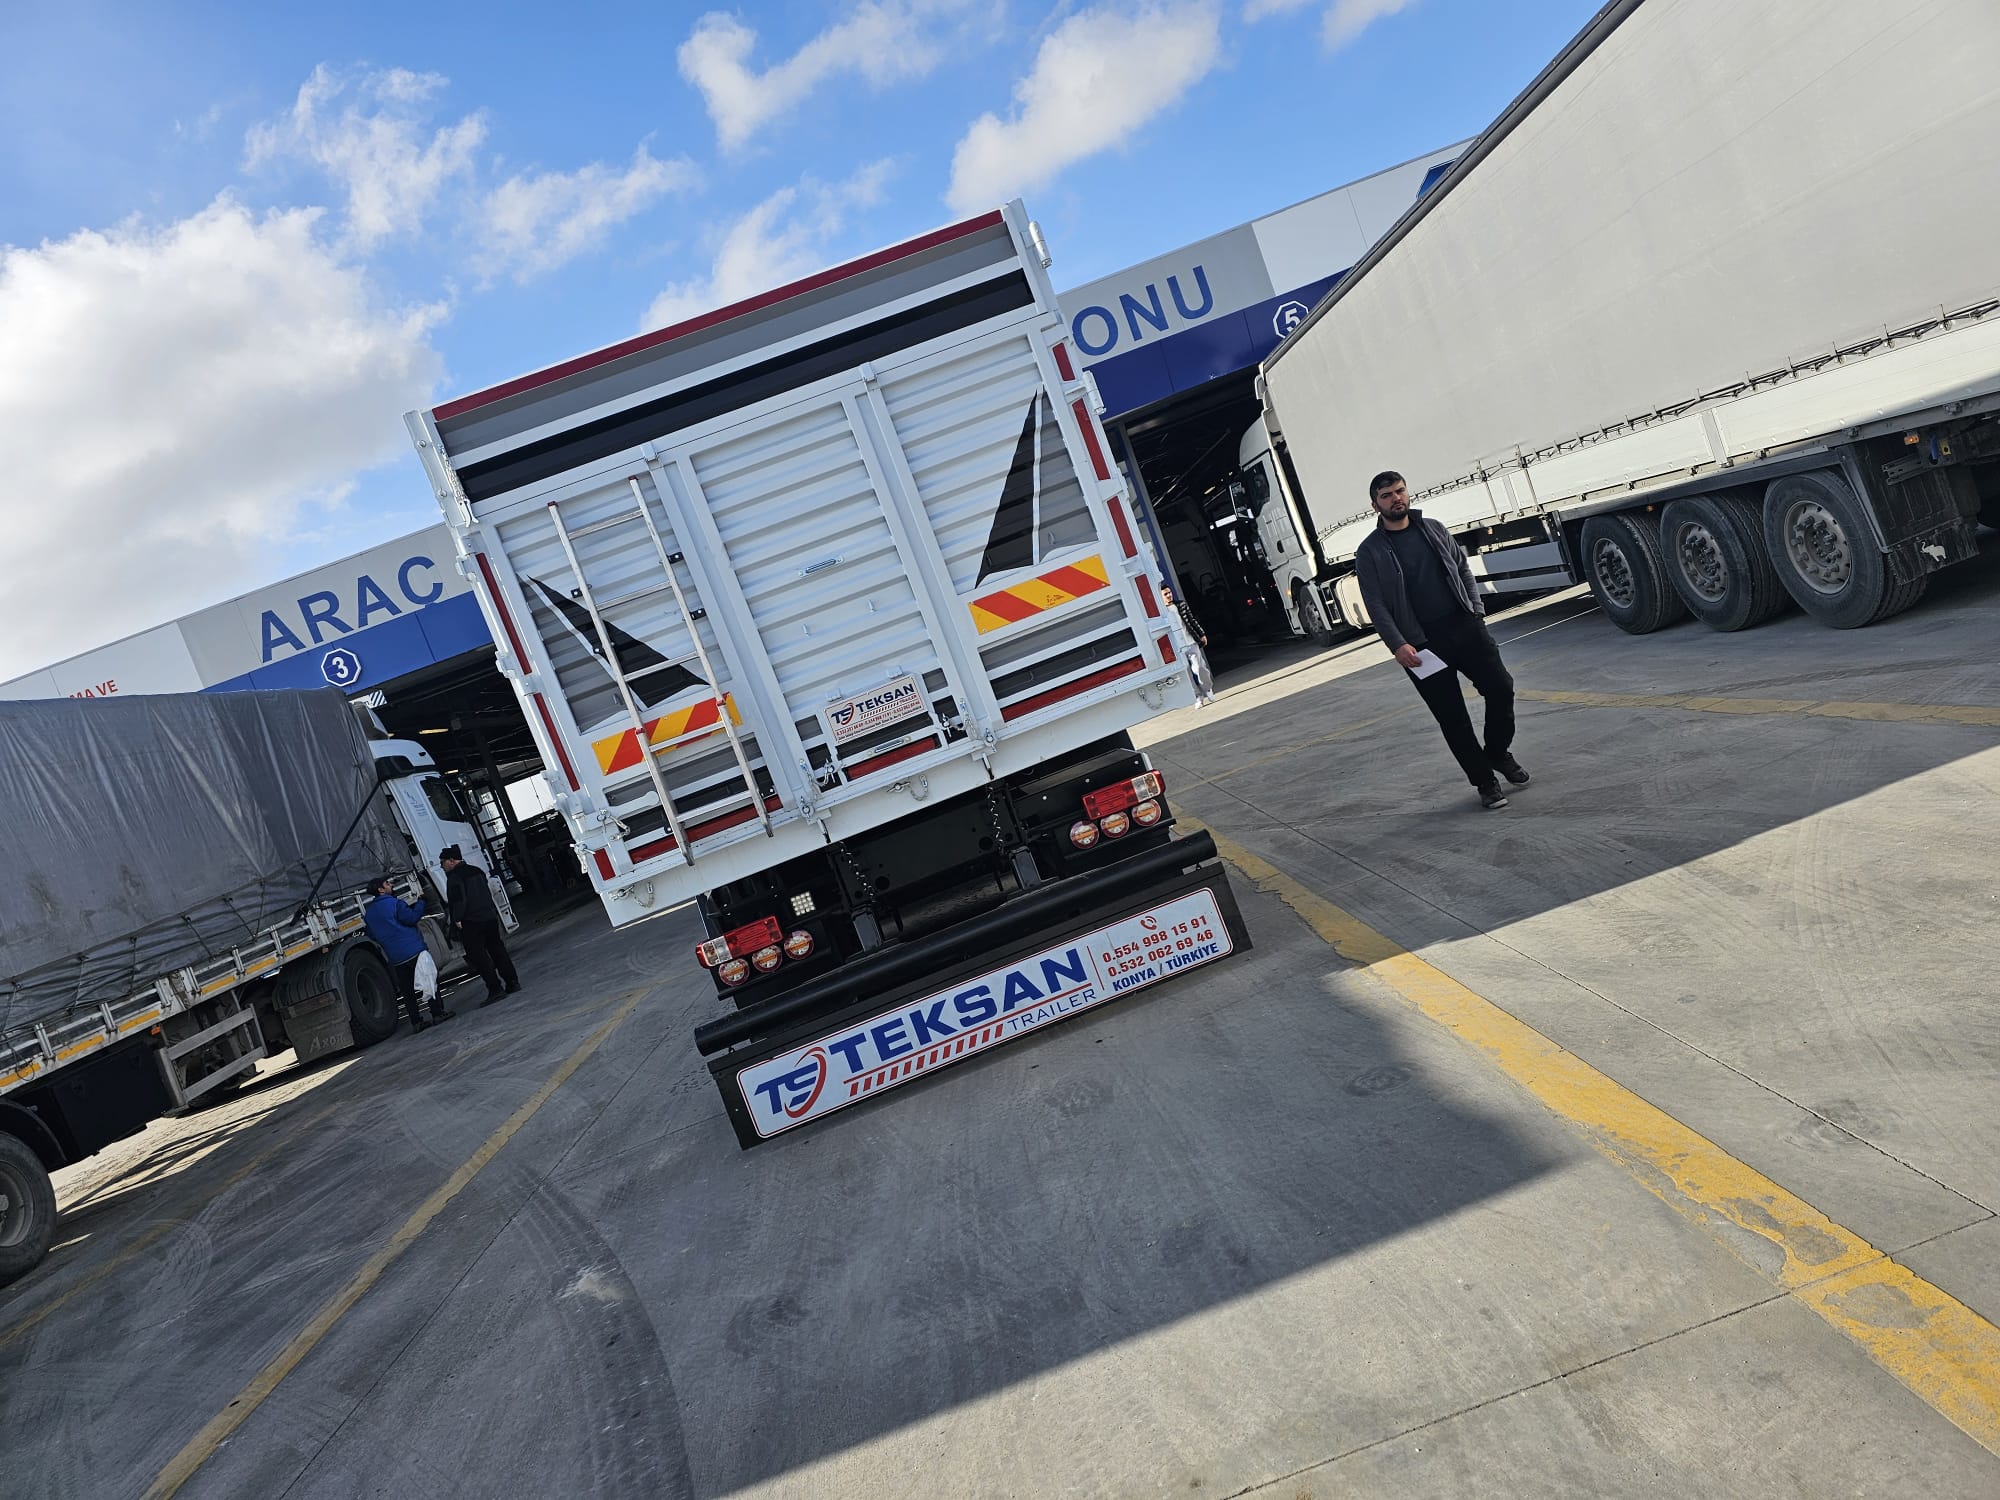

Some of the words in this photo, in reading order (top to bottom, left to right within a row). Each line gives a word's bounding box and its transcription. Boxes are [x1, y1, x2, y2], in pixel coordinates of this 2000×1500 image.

[1284, 308, 1301, 332] 5
[96, 680, 118, 696] VE
[332, 656, 349, 679] 3
[856, 684, 915, 712] TEKSAN
[1102, 942, 1139, 962] 0.554
[1143, 930, 1168, 947] 998
[1171, 923, 1188, 936] 15
[1191, 915, 1207, 928] 91
[1107, 955, 1145, 977] 0.532
[1148, 945, 1173, 961] 062
[1176, 937, 1193, 951] 69
[1197, 929, 1213, 942] 46
[1112, 967, 1156, 991] KONYA
[1165, 942, 1219, 970] TÜRKİYE
[828, 949, 1088, 1073] TEKSAN
[1007, 988, 1096, 1031] TRAILER
